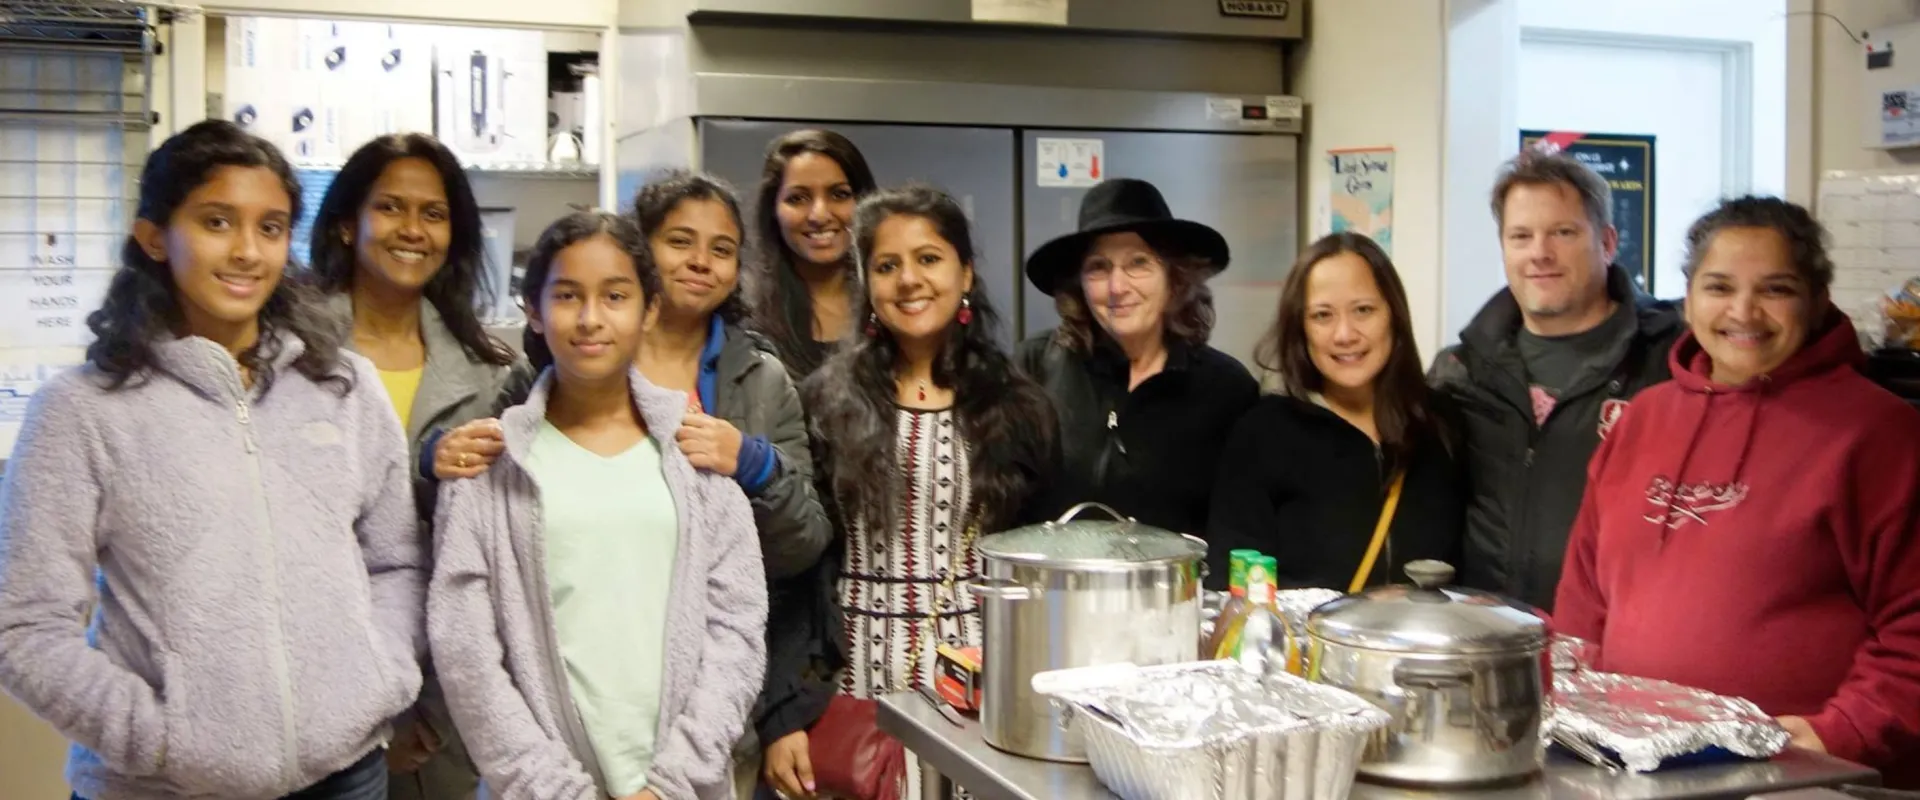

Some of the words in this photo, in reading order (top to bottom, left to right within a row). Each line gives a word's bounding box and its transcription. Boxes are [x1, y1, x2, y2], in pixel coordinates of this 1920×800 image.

[1226, 2, 1284, 14] HOBART
[29, 254, 75, 265] WASH
[32, 275, 73, 286] YOUR
[29, 296, 79, 308] HANDS
[36, 316, 72, 328] HERE
